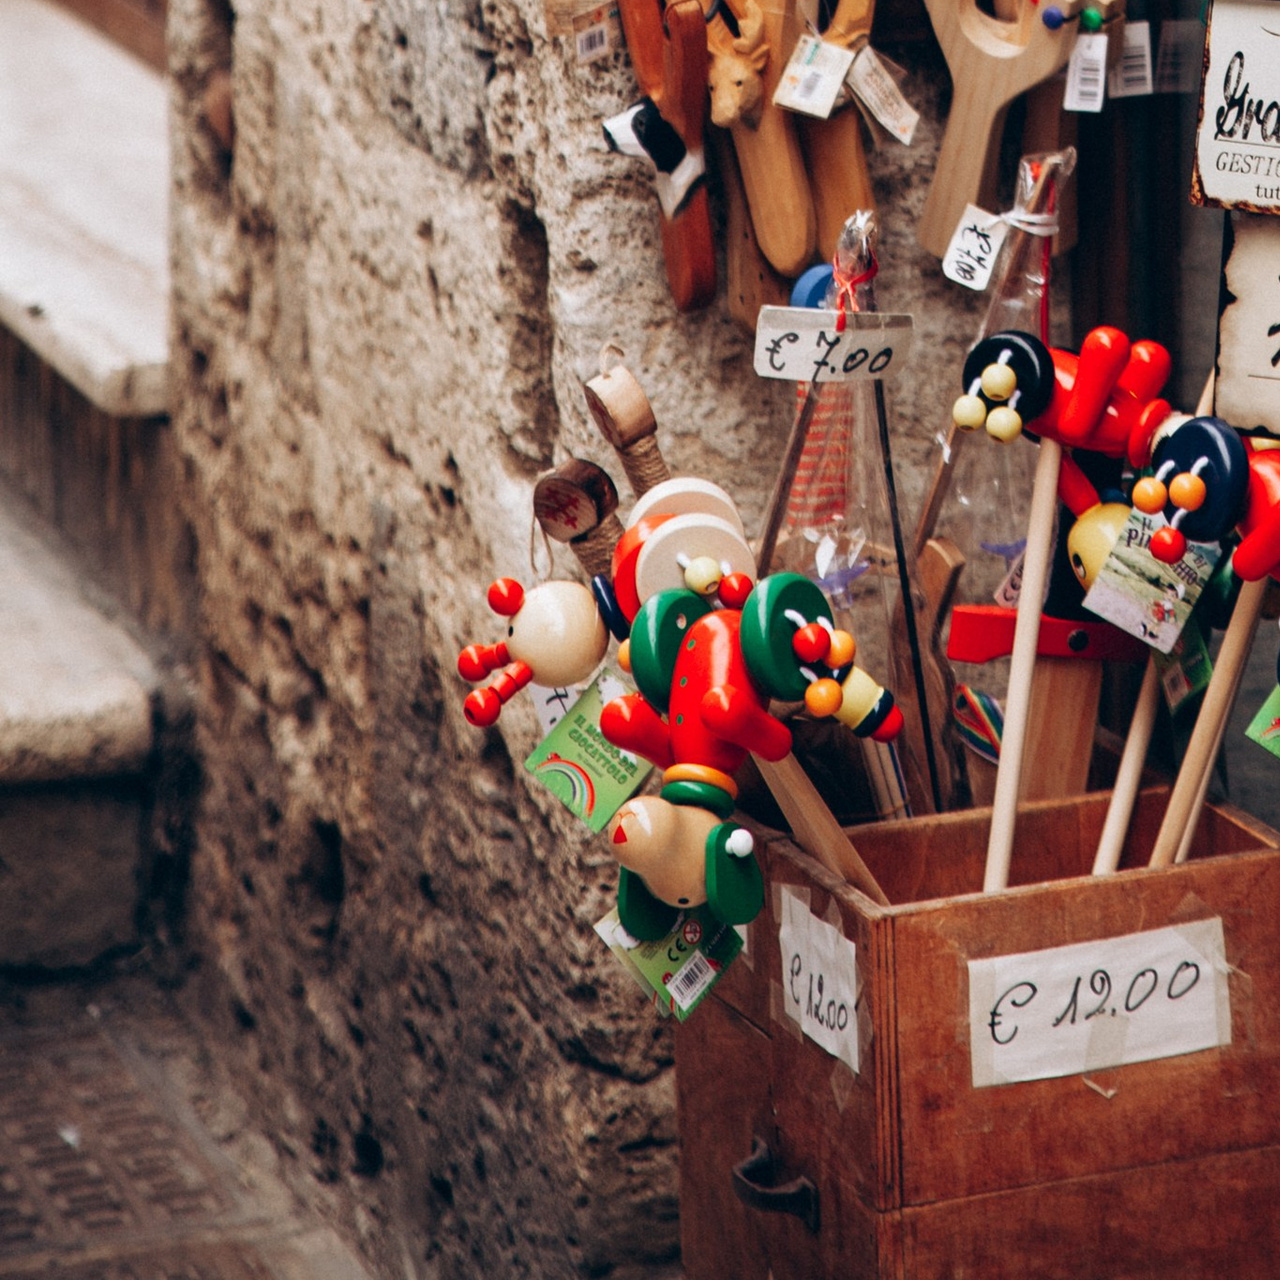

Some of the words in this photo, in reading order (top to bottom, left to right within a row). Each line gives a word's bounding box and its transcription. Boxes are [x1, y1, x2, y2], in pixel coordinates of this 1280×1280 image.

[763, 332, 799, 372] €
[811, 332, 894, 373] 7.00
[805, 972, 849, 1033] 12.00
[987, 981, 1038, 1045] €
[1051, 959, 1201, 1028] 12.00
